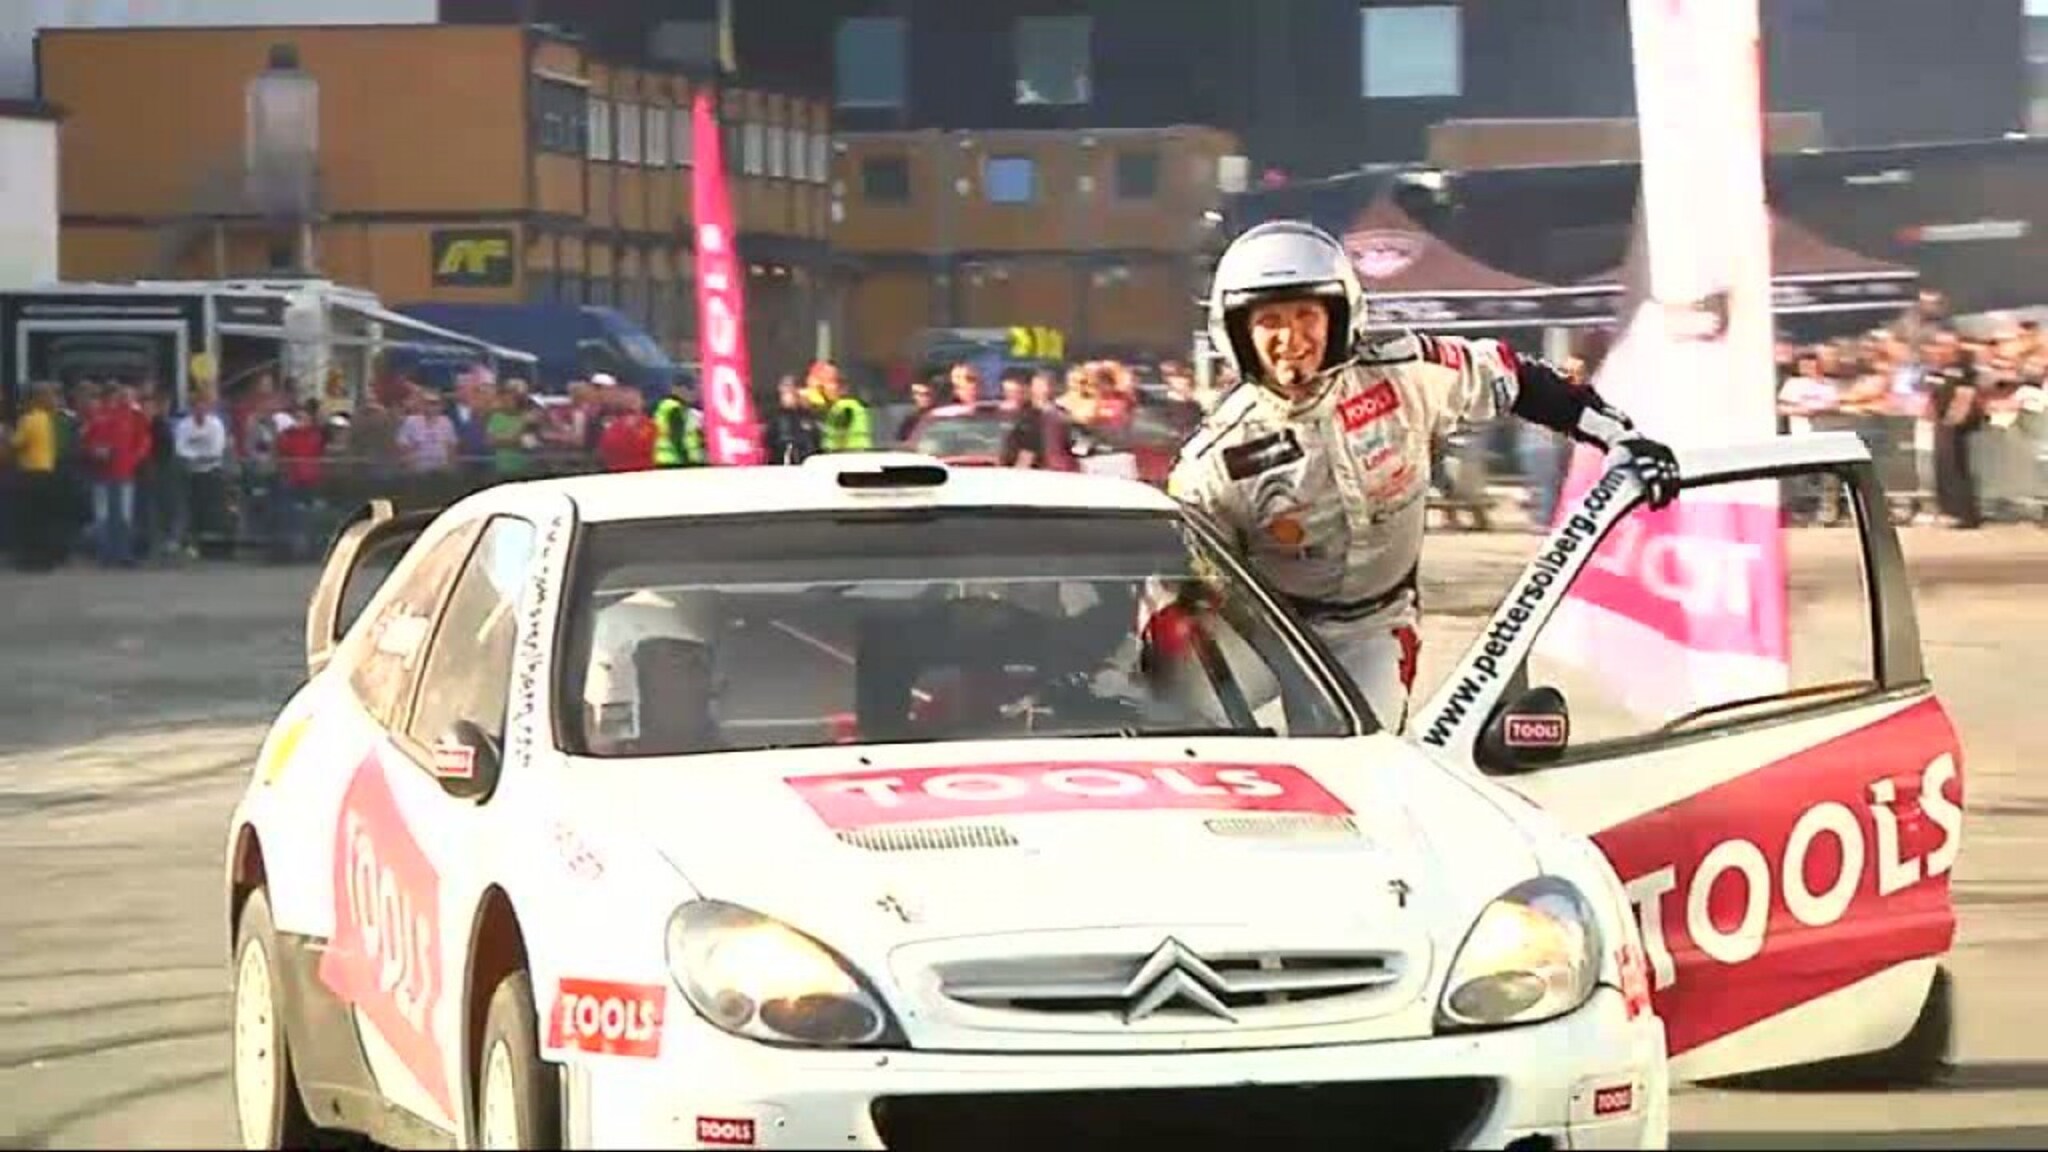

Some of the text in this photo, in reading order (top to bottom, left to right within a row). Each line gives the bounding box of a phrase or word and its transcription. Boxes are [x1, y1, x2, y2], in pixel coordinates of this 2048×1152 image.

[1423, 467, 1629, 747] www.pettersolberg.com
[1512, 722, 1559, 738] TOOLS
[820, 768, 1284, 807] TOOLS
[1624, 752, 1963, 991] TOOLS
[561, 993, 655, 1041] TOOLS
[702, 1120, 750, 1140] TOOLS
